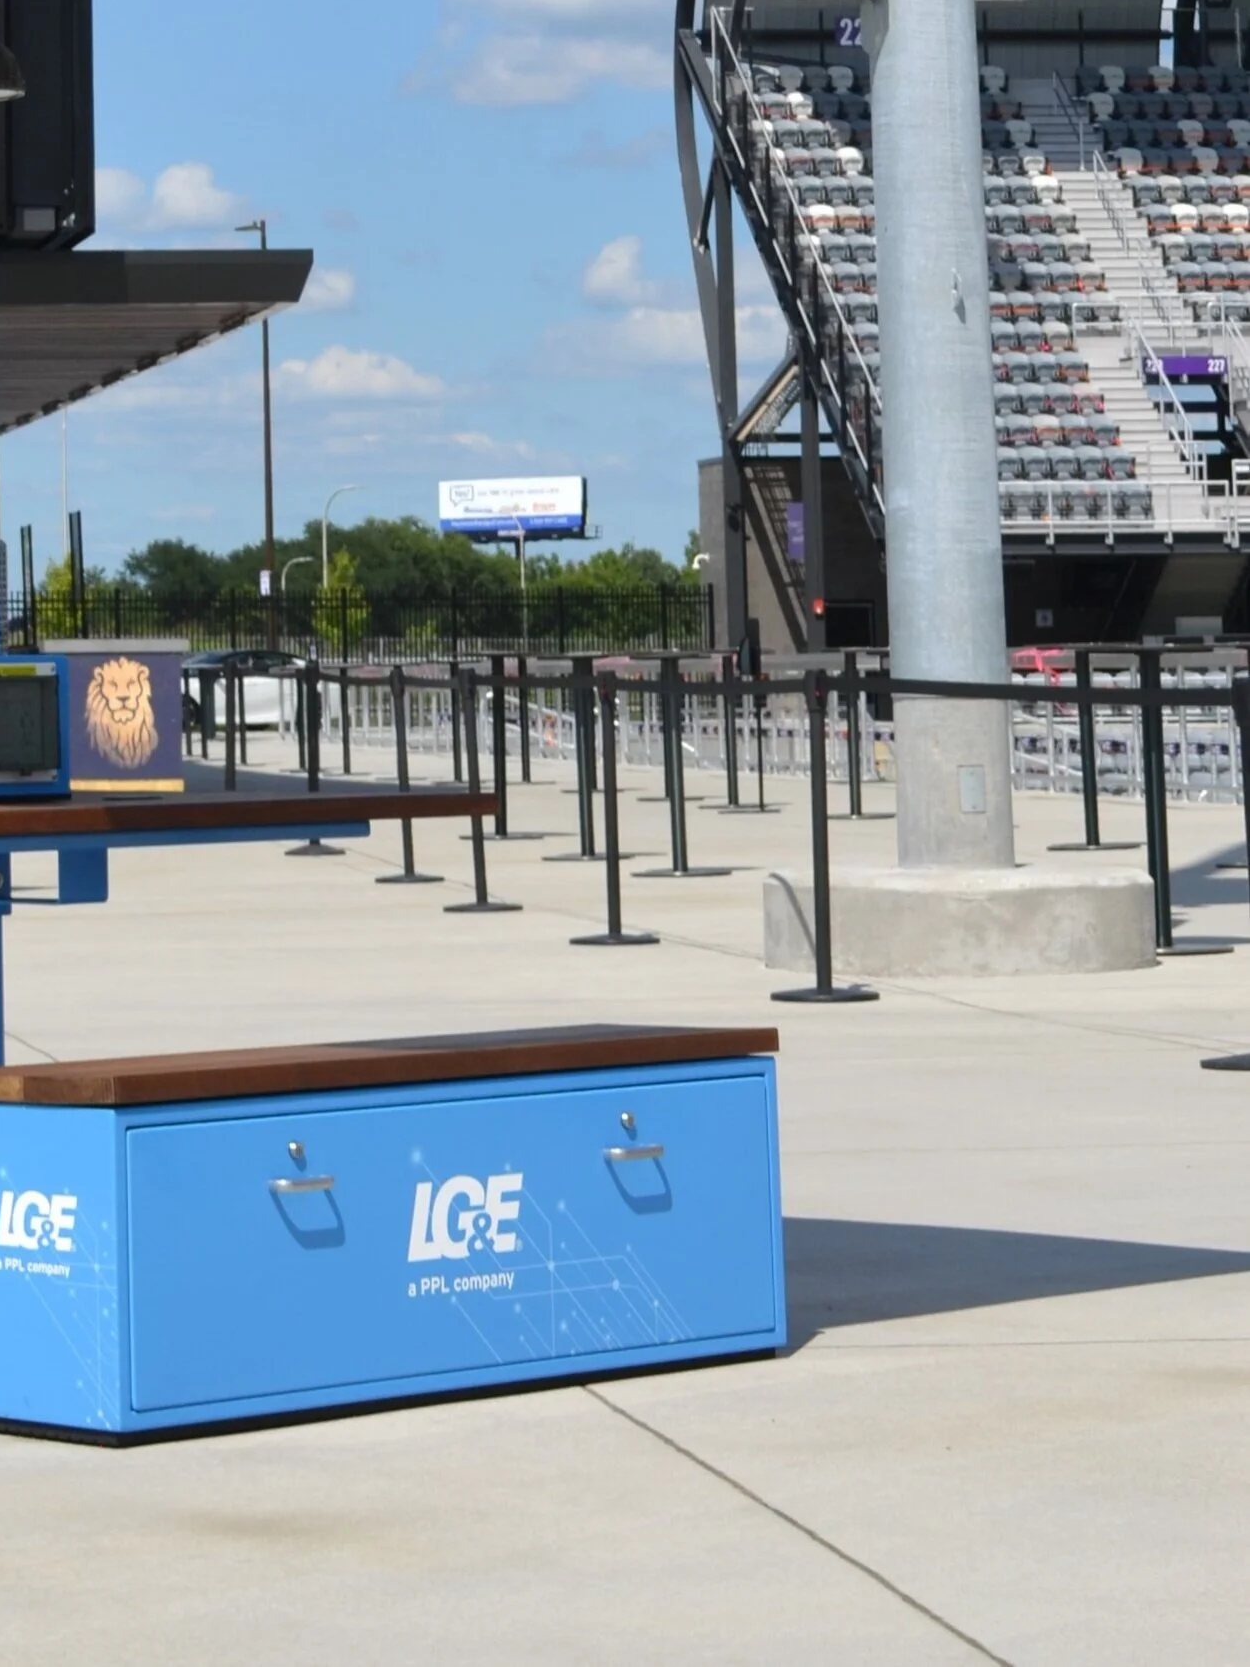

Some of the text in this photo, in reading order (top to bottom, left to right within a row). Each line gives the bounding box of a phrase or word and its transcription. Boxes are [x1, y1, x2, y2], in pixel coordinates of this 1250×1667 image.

[1207, 358, 1225, 373] 227
[408, 1172, 523, 1262] LG&E
[4, 1256, 25, 1272] PPL
[27, 1262, 71, 1279] company
[408, 1270, 515, 1297] a PPL company
